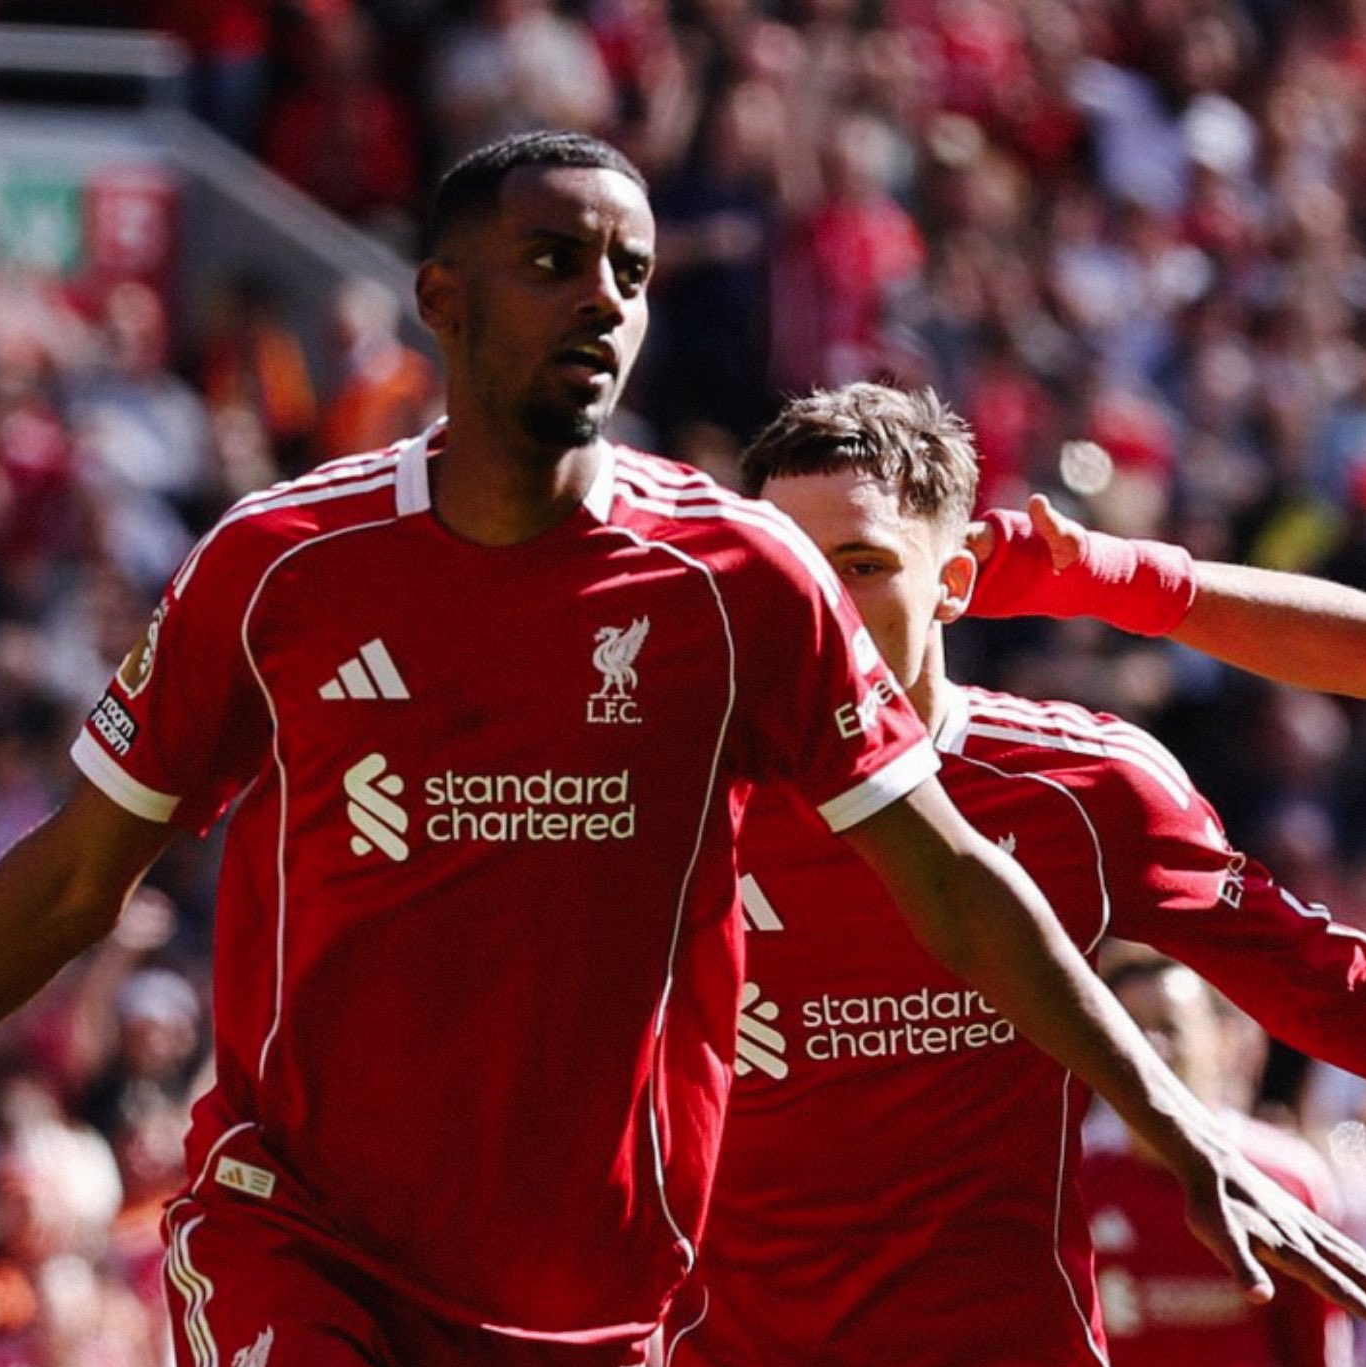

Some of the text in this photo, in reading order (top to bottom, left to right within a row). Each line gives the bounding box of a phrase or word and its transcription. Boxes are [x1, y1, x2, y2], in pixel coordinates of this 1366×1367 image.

[102, 695, 135, 738] room
[424, 769, 629, 806] standard
[426, 803, 636, 842] chartered
